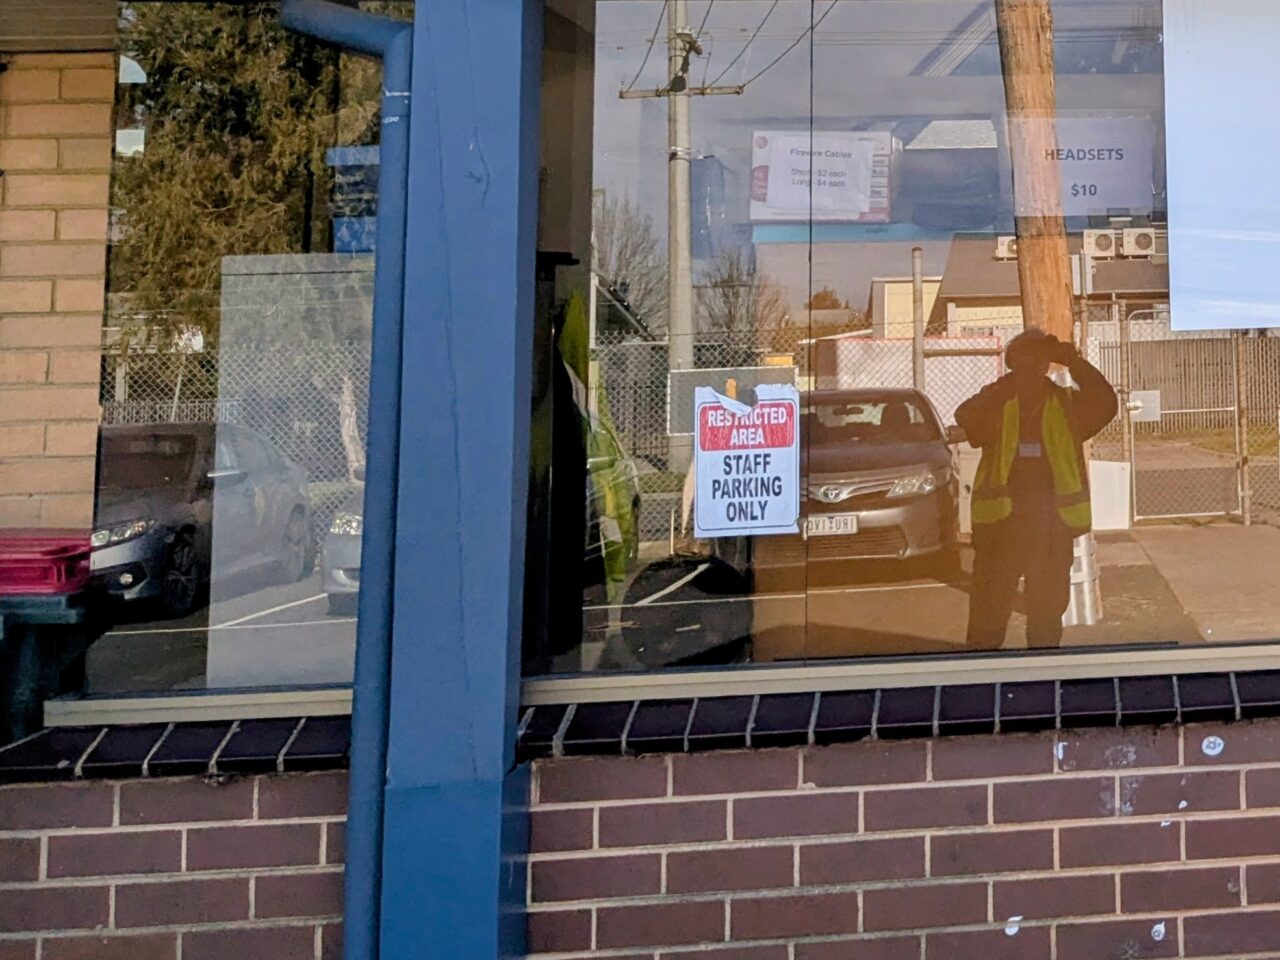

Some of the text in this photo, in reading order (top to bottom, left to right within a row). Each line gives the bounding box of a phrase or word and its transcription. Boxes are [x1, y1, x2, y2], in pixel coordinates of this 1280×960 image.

[1044, 148, 1124, 161] HEADSETS
[791, 168, 812, 176] Shor
[1071, 183, 1098, 197] $10
[730, 428, 765, 446] AREA
[723, 452, 772, 476] STAFF
[712, 476, 783, 500] PARKING
[726, 500, 769, 522] ONLY
